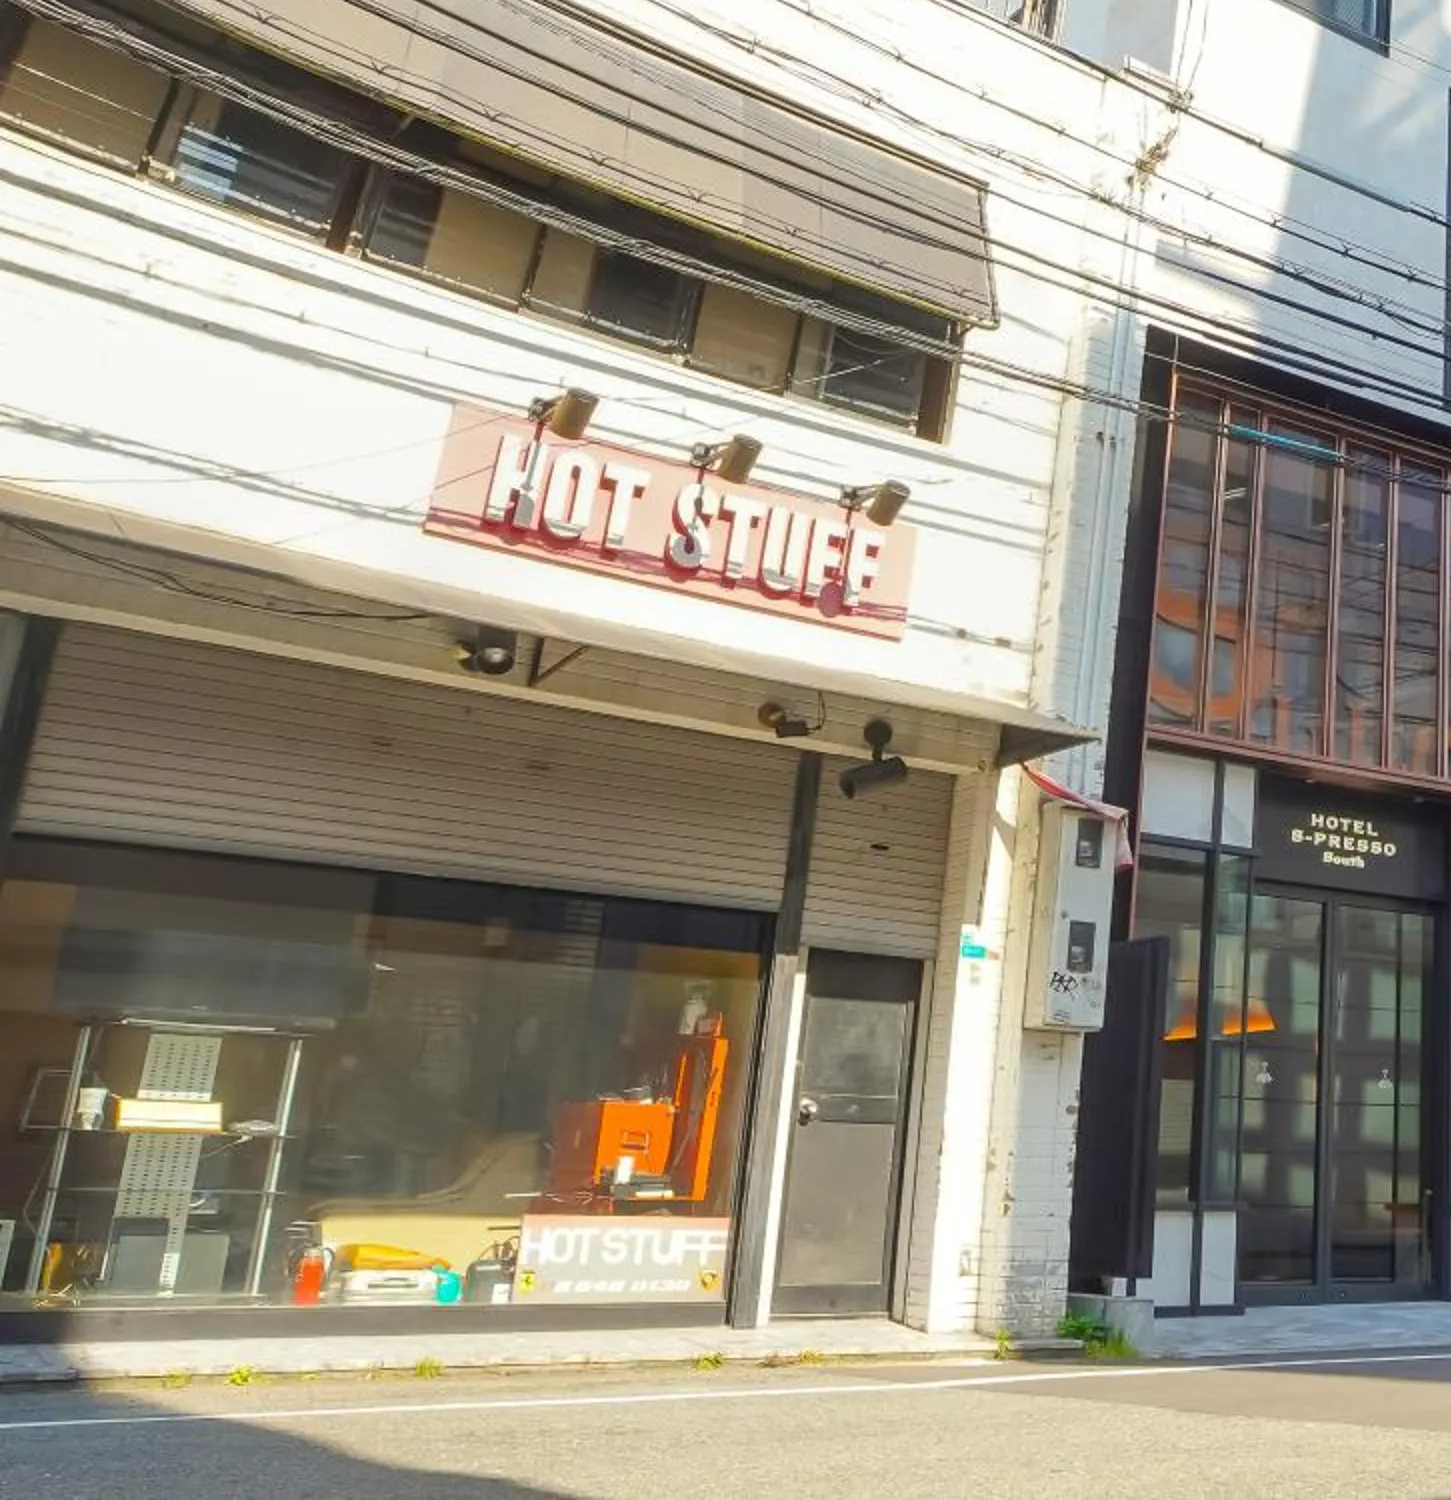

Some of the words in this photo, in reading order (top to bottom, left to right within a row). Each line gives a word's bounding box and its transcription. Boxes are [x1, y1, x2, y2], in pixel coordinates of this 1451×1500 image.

[484, 432, 652, 555] HOT
[665, 482, 887, 610] STUFF
[1310, 813, 1379, 837] HOTEL
[1291, 828, 1397, 857] S-PRESSO
[1323, 851, 1365, 869] South
[521, 1226, 601, 1267] HOT
[602, 1227, 729, 1267] STUFF
